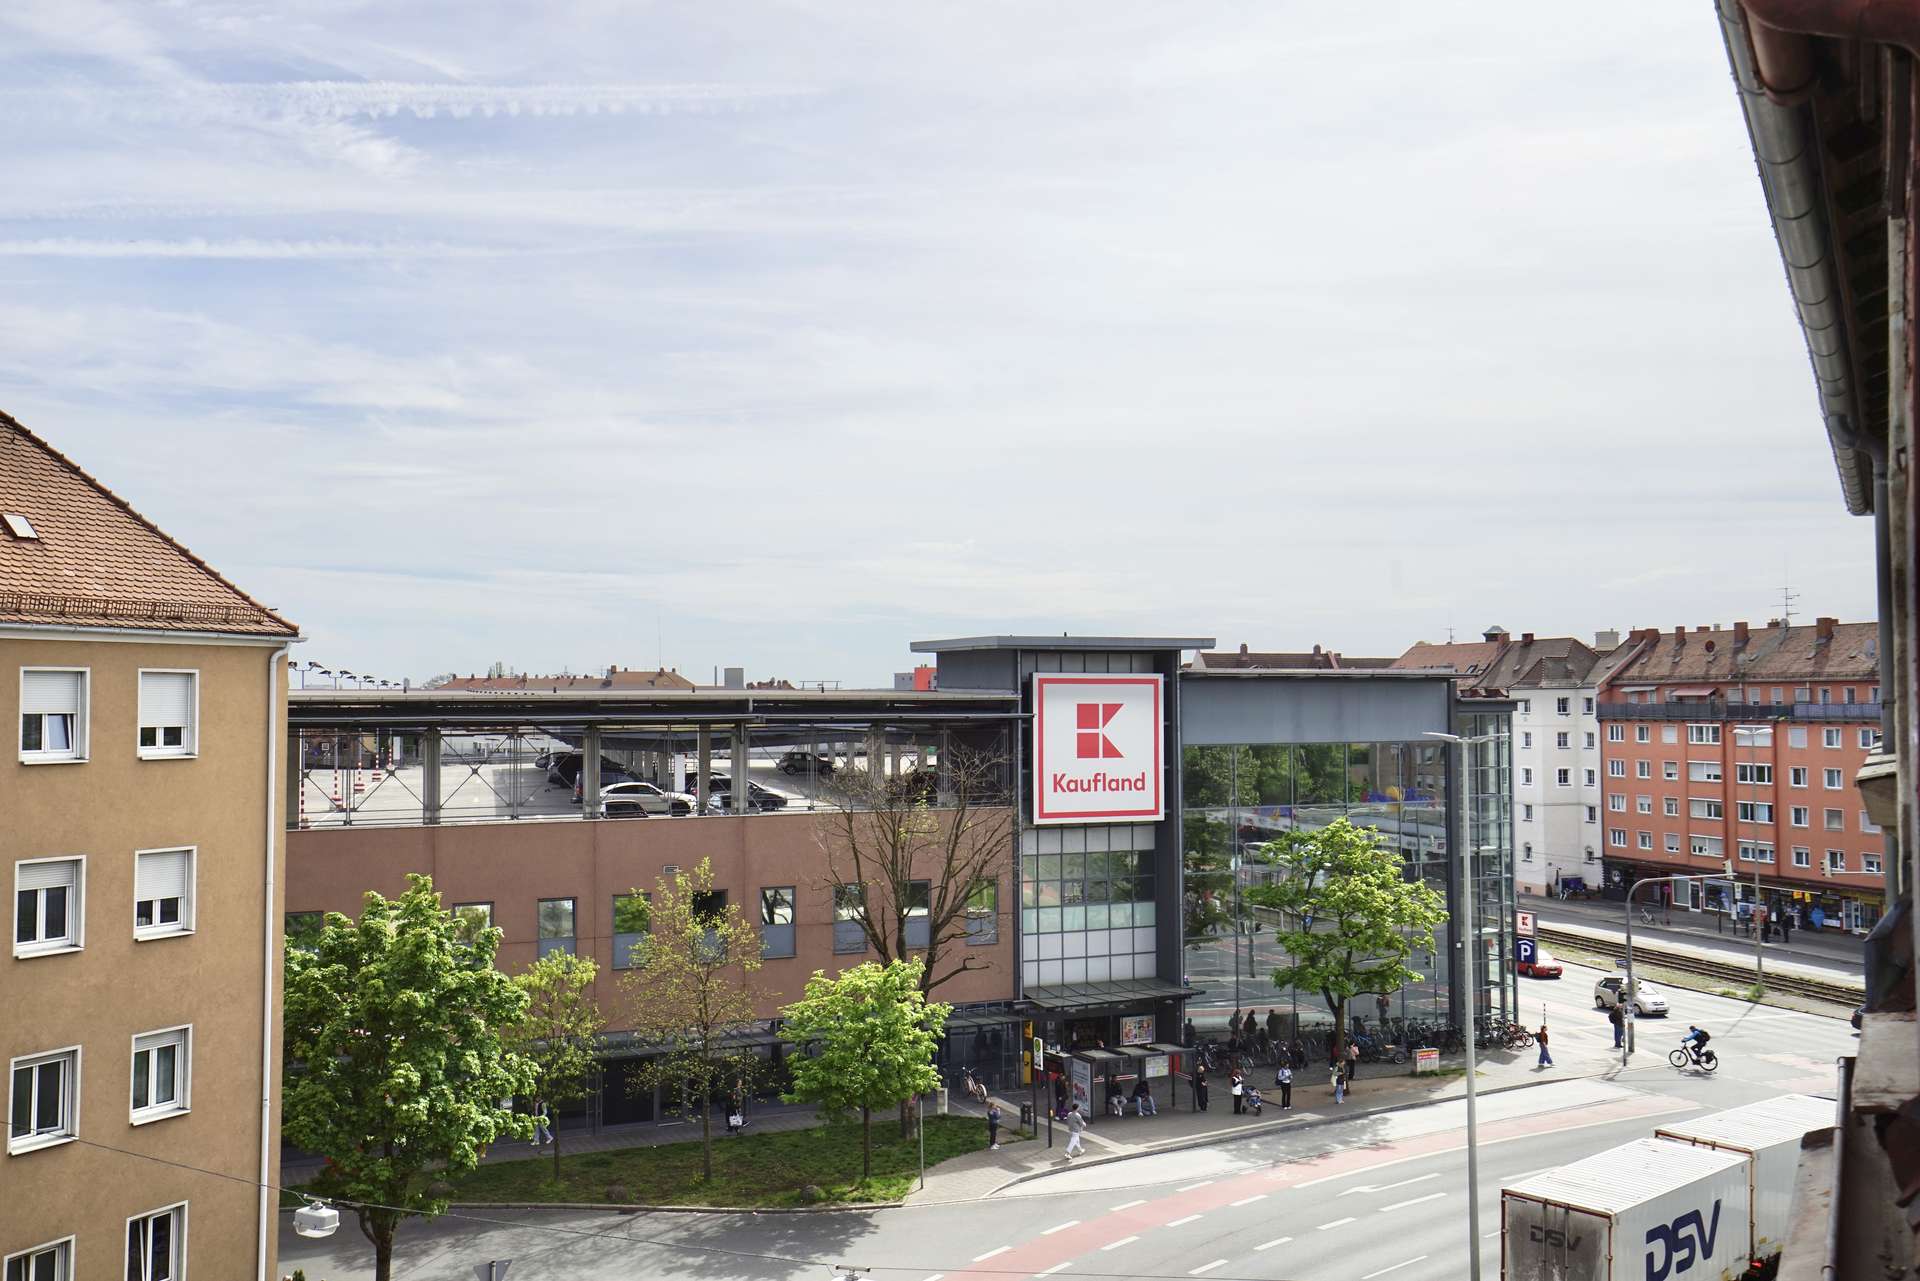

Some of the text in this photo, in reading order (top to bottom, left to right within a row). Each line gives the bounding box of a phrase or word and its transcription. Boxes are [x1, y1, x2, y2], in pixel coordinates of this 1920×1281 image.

[1076, 703, 1125, 759] K
[1052, 771, 1146, 793] Kaufland
[1521, 944, 1531, 961] P
[1530, 1225, 1581, 1251] DSV
[1645, 1199, 1722, 1281] DSV
